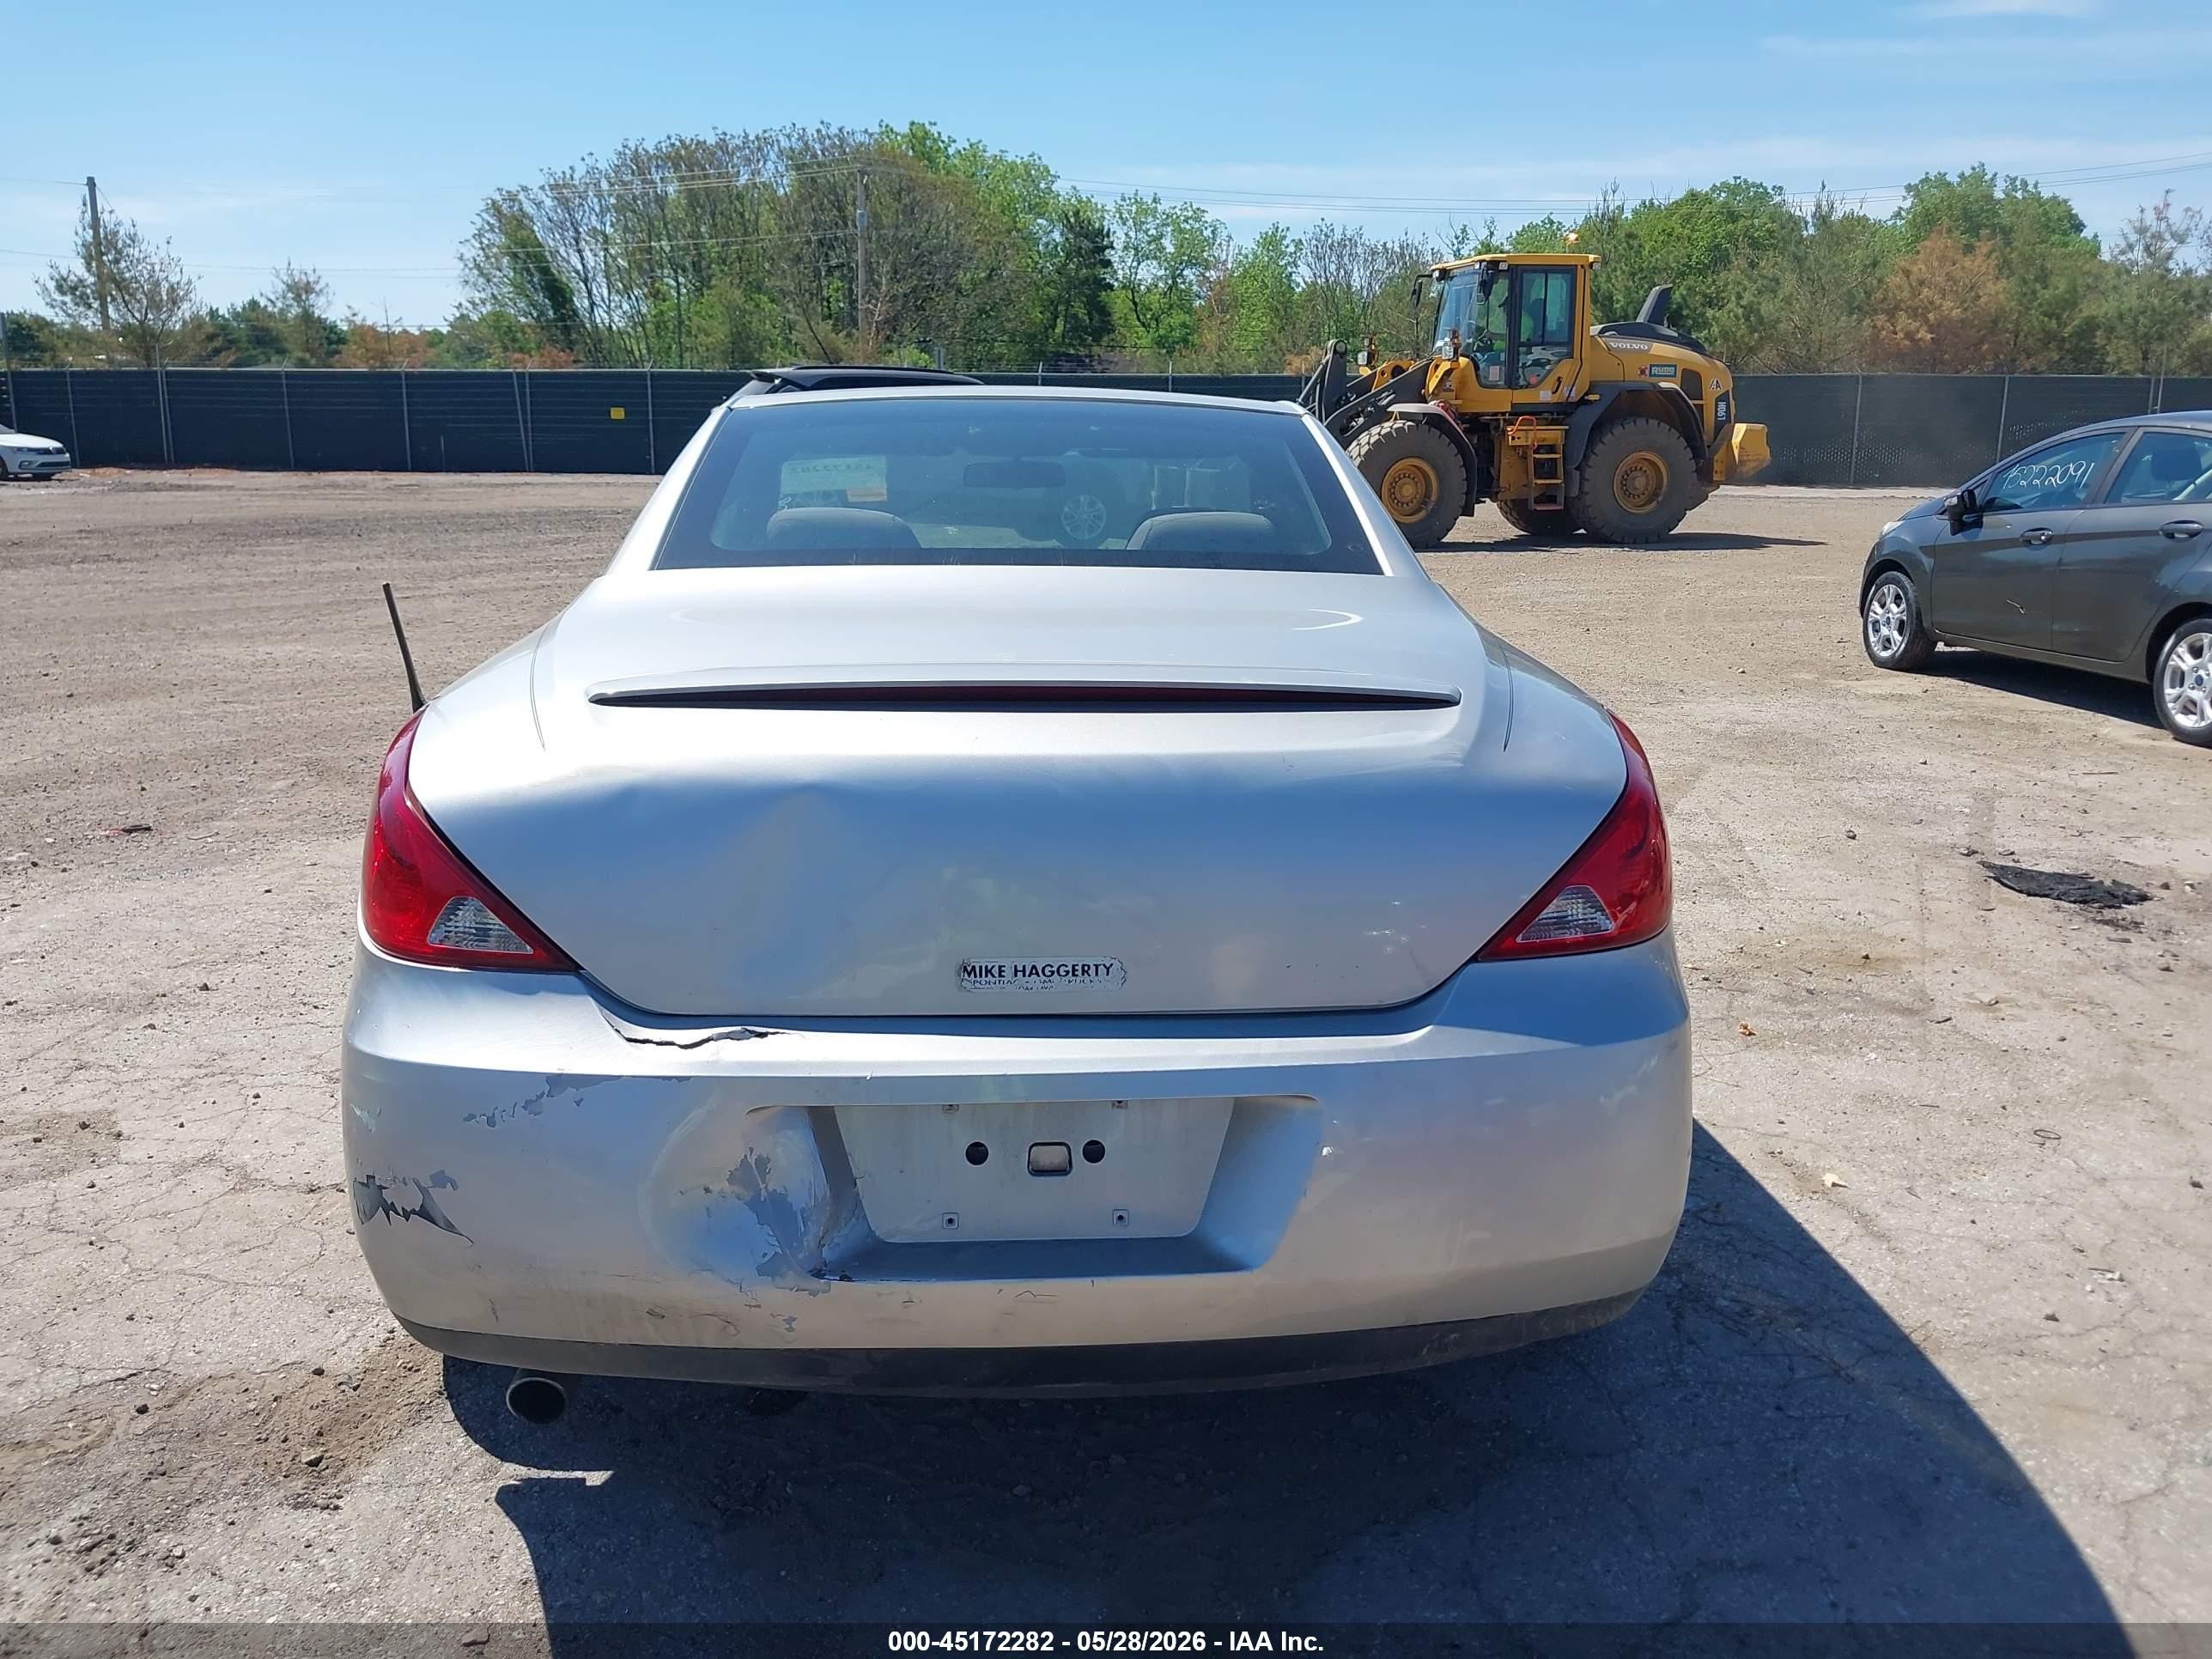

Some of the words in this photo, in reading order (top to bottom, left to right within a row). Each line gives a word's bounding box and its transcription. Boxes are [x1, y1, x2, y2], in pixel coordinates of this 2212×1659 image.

[1608, 341, 1649, 350] VOLVO
[1717, 401, 1727, 421] L90H
[962, 964, 1006, 978] MIKE
[1013, 963, 1114, 978] HAGGERTY
